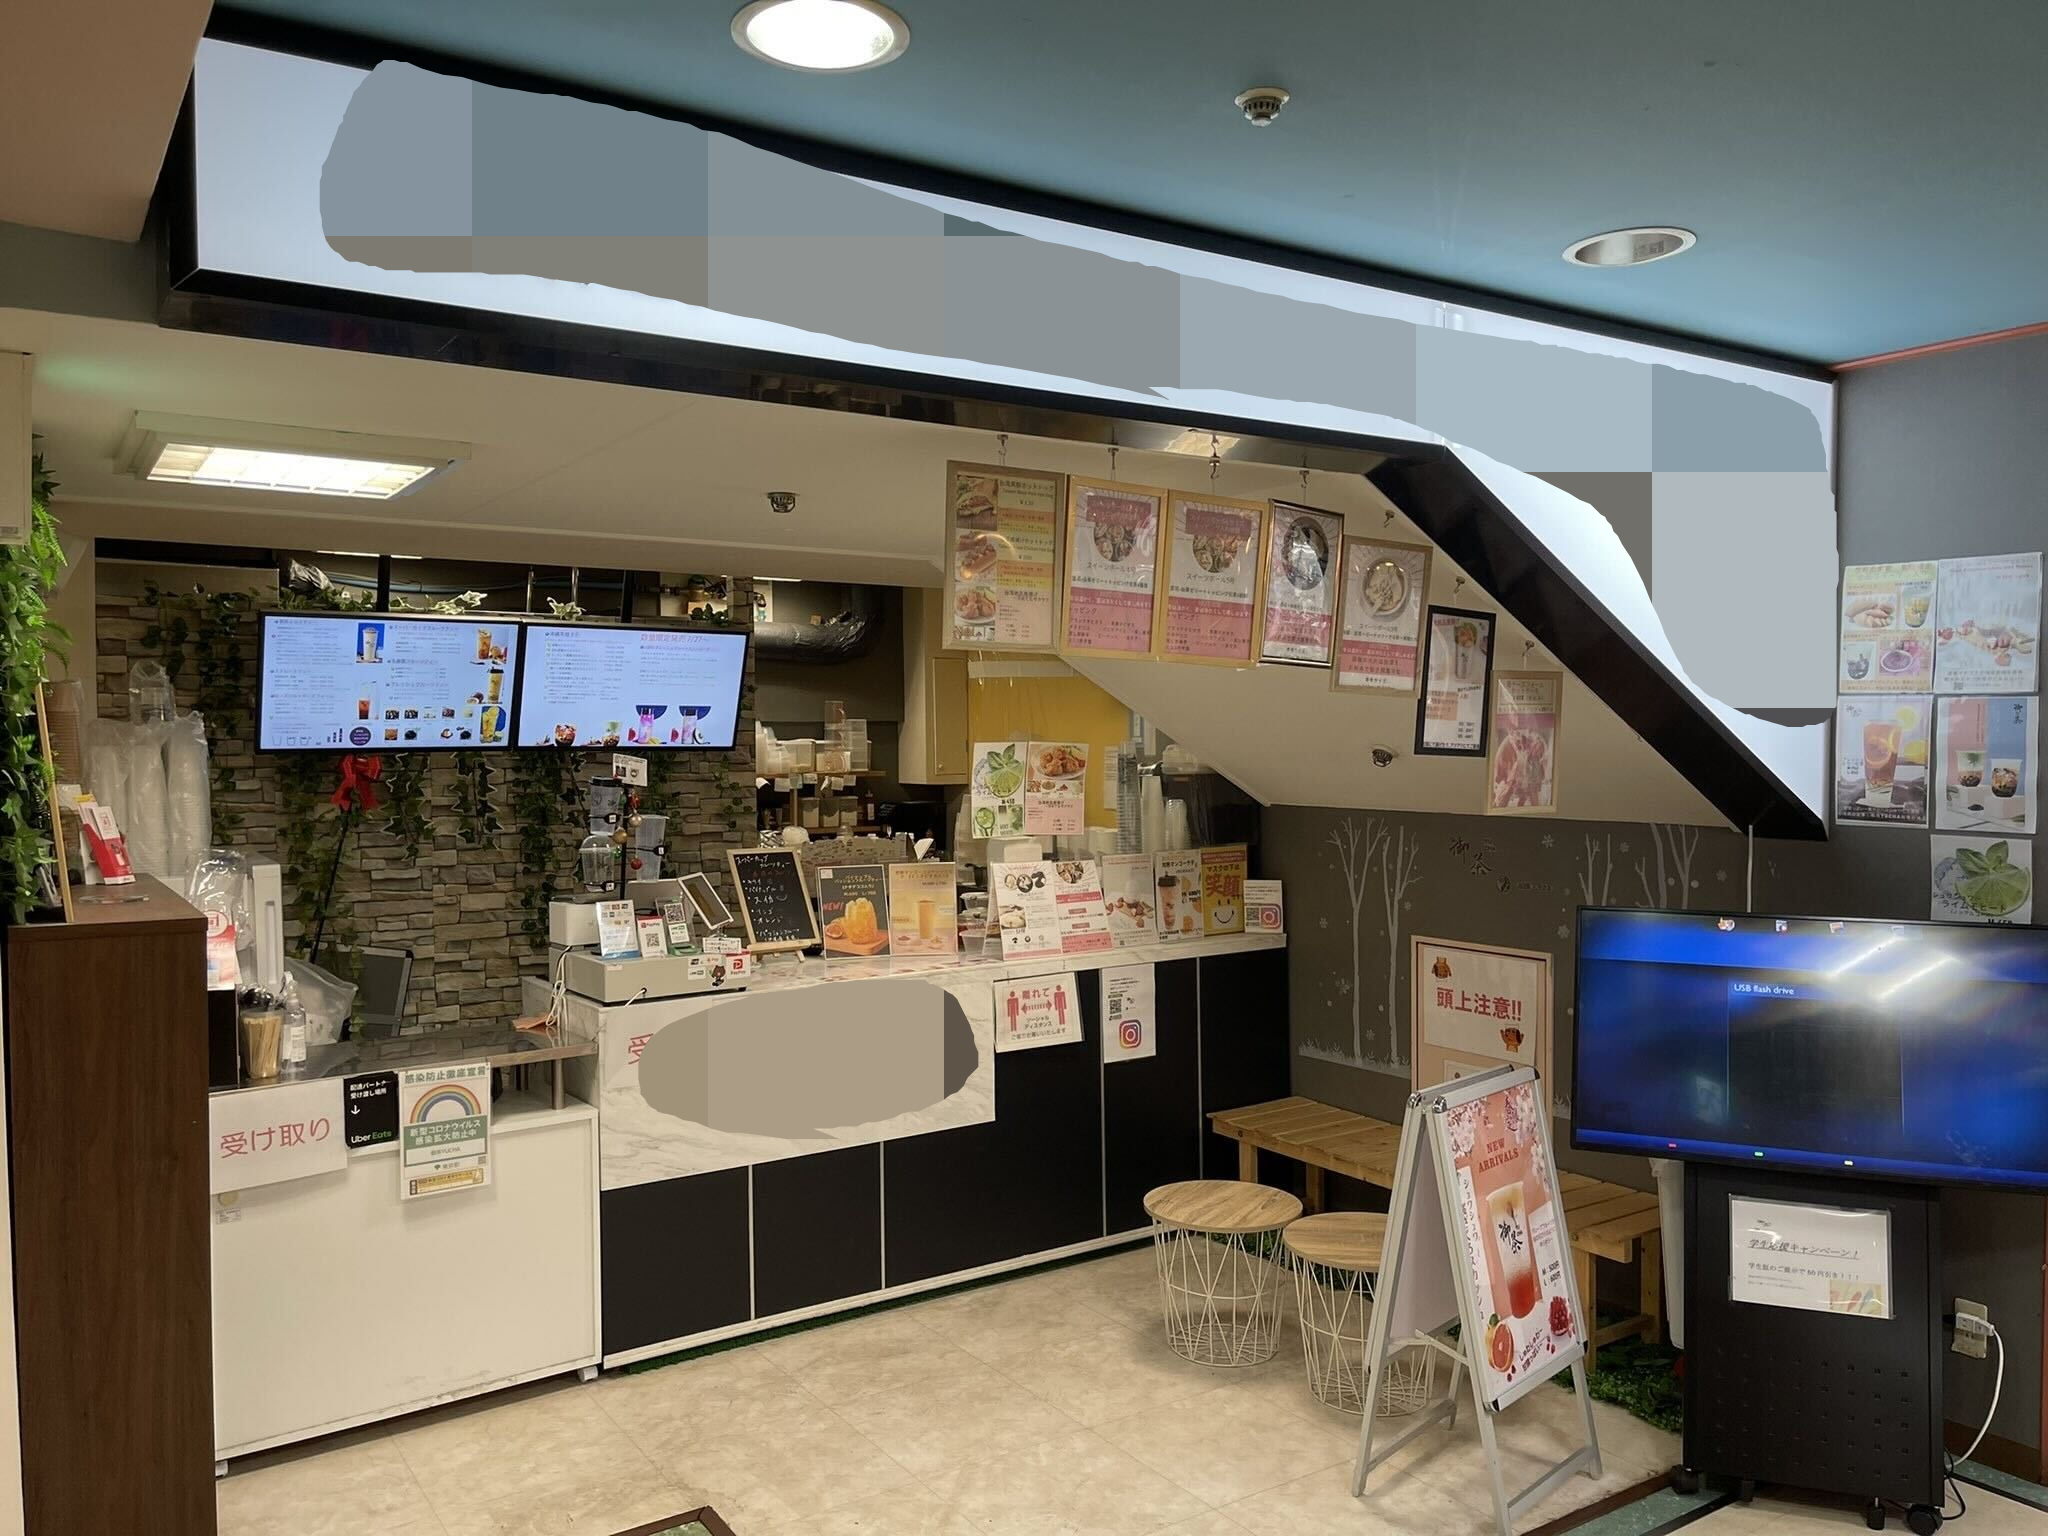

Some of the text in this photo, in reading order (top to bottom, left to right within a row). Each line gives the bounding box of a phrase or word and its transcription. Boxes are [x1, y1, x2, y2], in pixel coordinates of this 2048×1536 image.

[1733, 983, 1795, 996] USB flash drive
[409, 1118, 482, 1137] 新型コロナウイルス
[219, 1117, 331, 1159] 受け取り
[351, 1129, 392, 1144] Uber Eats
[415, 1129, 478, 1146] 感染拡大防止中
[1486, 1137, 1506, 1154] NEW
[1477, 1147, 1520, 1174] ARRIVALS
